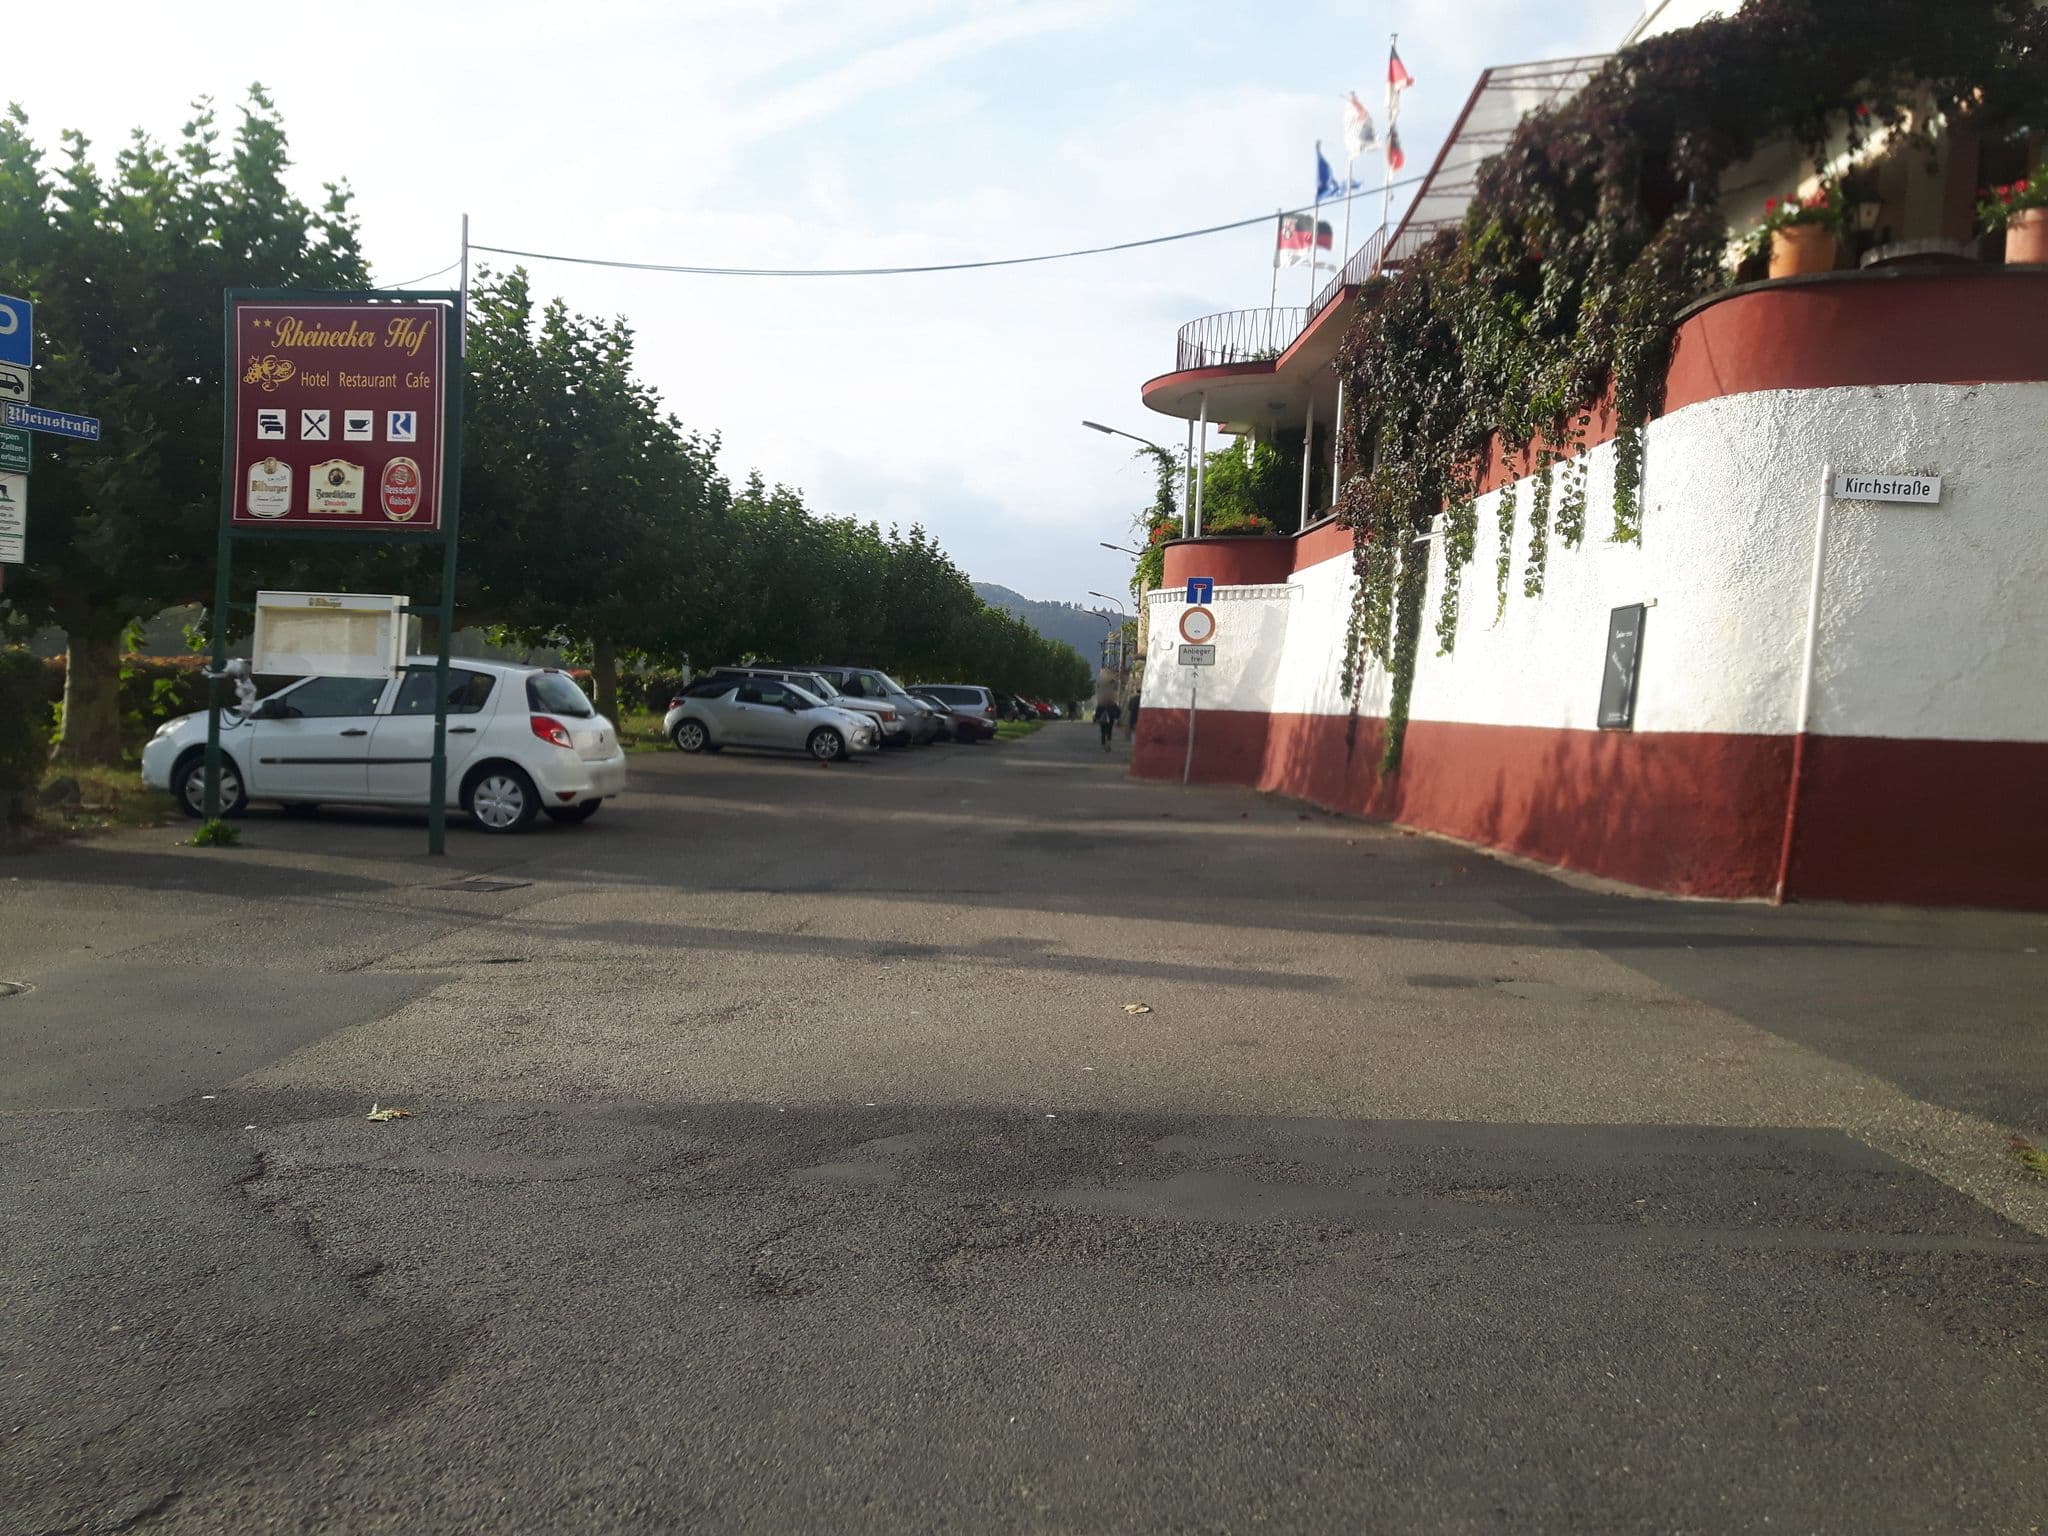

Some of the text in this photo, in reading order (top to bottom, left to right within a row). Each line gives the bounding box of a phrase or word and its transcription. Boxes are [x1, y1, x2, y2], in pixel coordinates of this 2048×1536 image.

[271, 316, 432, 356] Rheinecker Hof
[301, 370, 430, 388] Hotel Restaurant Cafe
[8, 406, 98, 434] Rheinstraße
[1845, 477, 1930, 496] Kirchstraße
[1183, 647, 1211, 657] Anlieger
